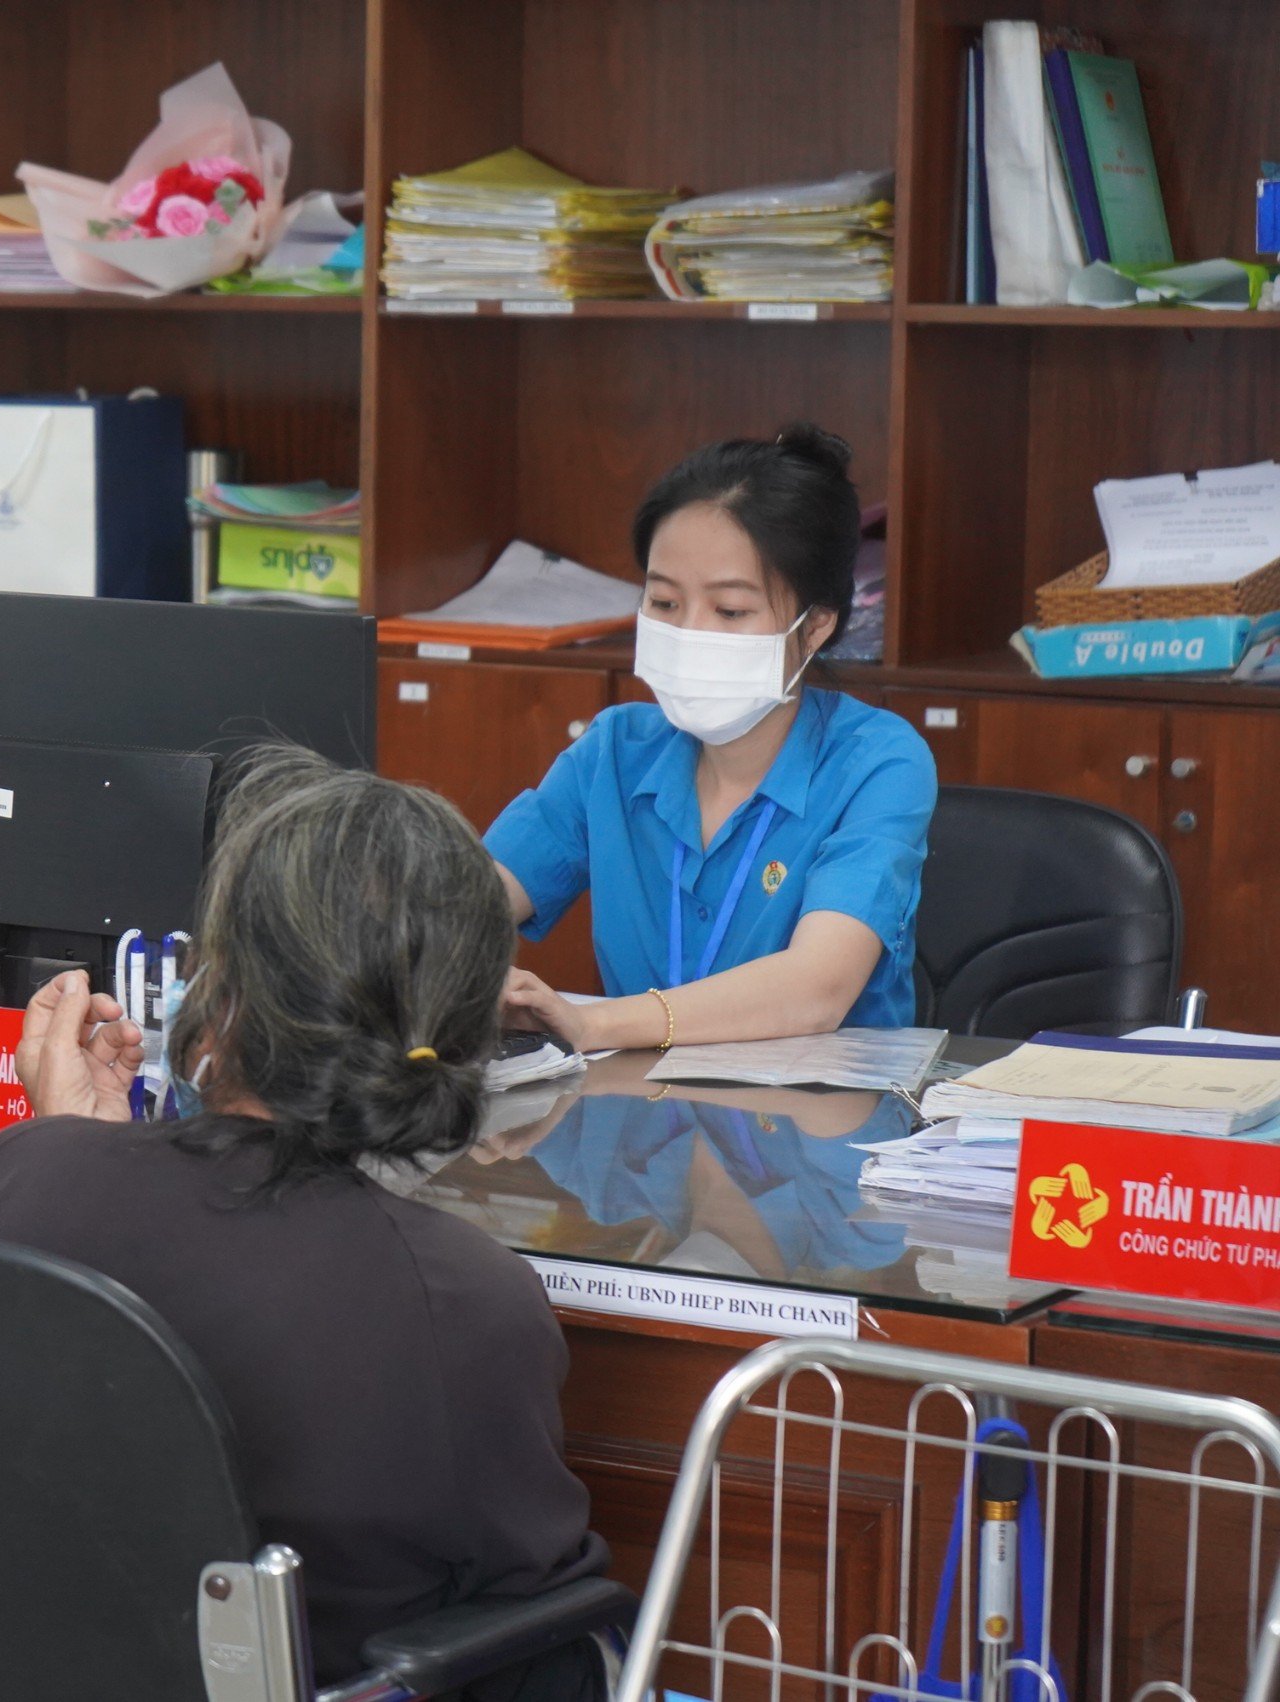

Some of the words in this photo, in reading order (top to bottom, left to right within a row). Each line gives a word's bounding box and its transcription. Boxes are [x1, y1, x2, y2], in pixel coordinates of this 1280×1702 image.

[1076, 645, 1093, 666] A
[1105, 637, 1204, 665] Double
[7, 1095, 27, 1119] HỘ
[1121, 1172, 1194, 1223] TRẦN
[1119, 1228, 1169, 1256] CÔNG
[1173, 1235, 1222, 1262] CHỨC
[1226, 1243, 1251, 1266] TƯ
[627, 1285, 676, 1305] UBND
[680, 1292, 724, 1311] HIEP
[728, 1298, 773, 1318] BINH
[778, 1304, 848, 1326] CHANH
